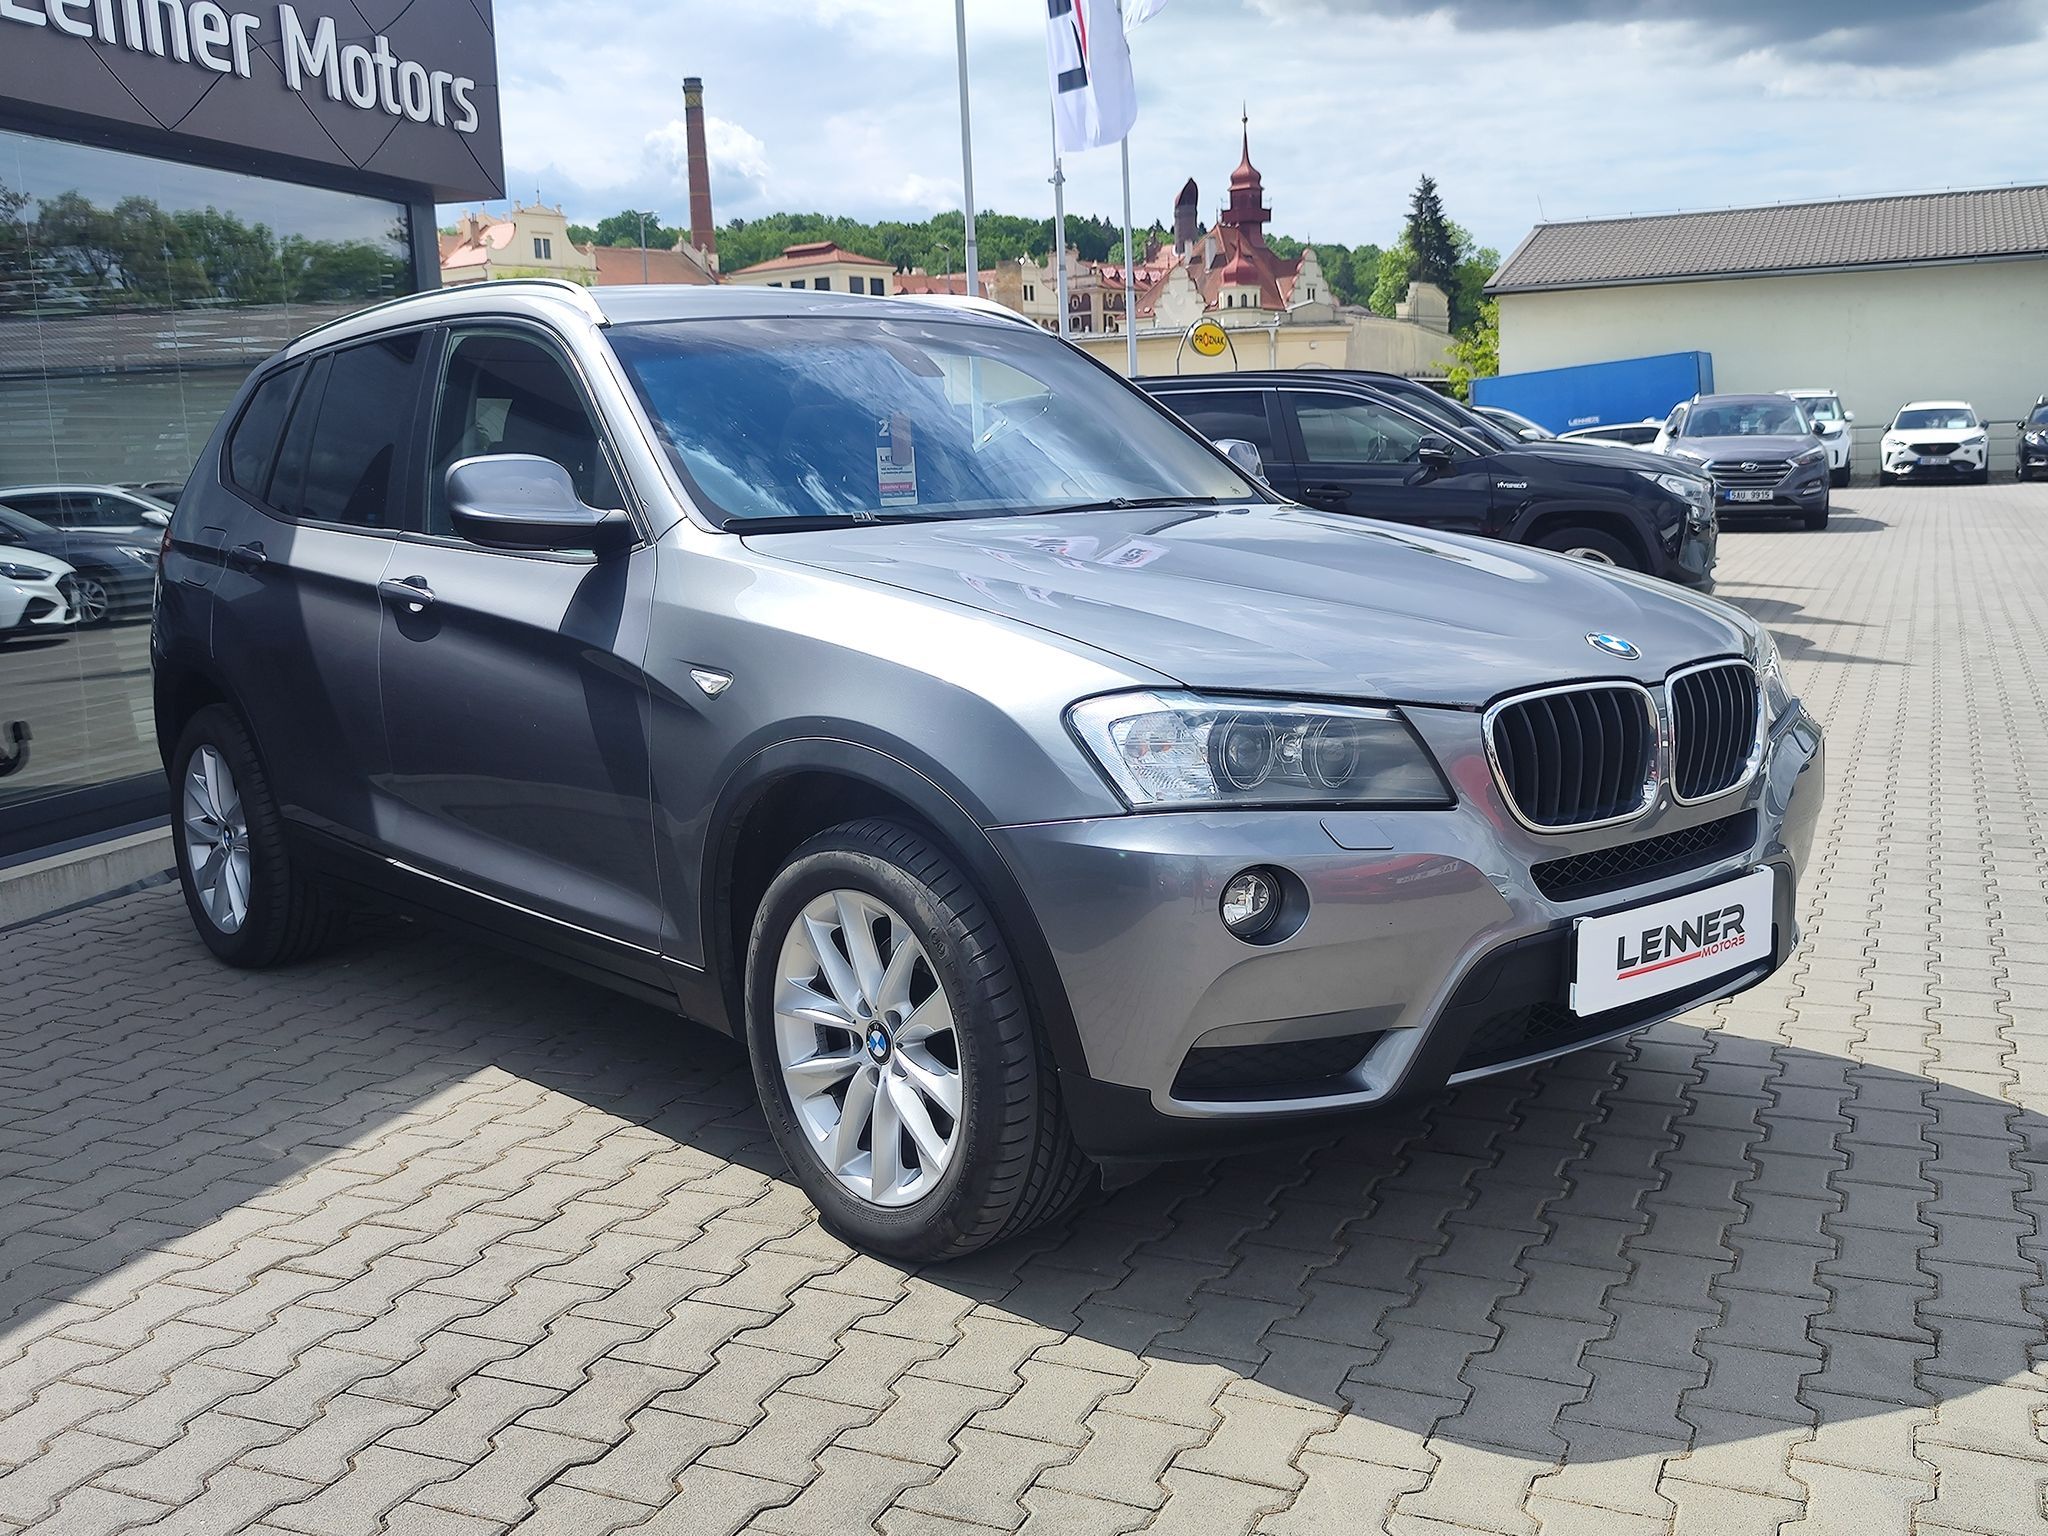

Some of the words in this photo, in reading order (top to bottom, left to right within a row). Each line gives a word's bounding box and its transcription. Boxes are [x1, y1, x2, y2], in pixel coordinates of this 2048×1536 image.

[0, 0, 261, 79] enner
[278, 3, 479, 134] Motors
[1616, 903, 1746, 970] LENNER
[1701, 934, 1746, 958] MOTORS
